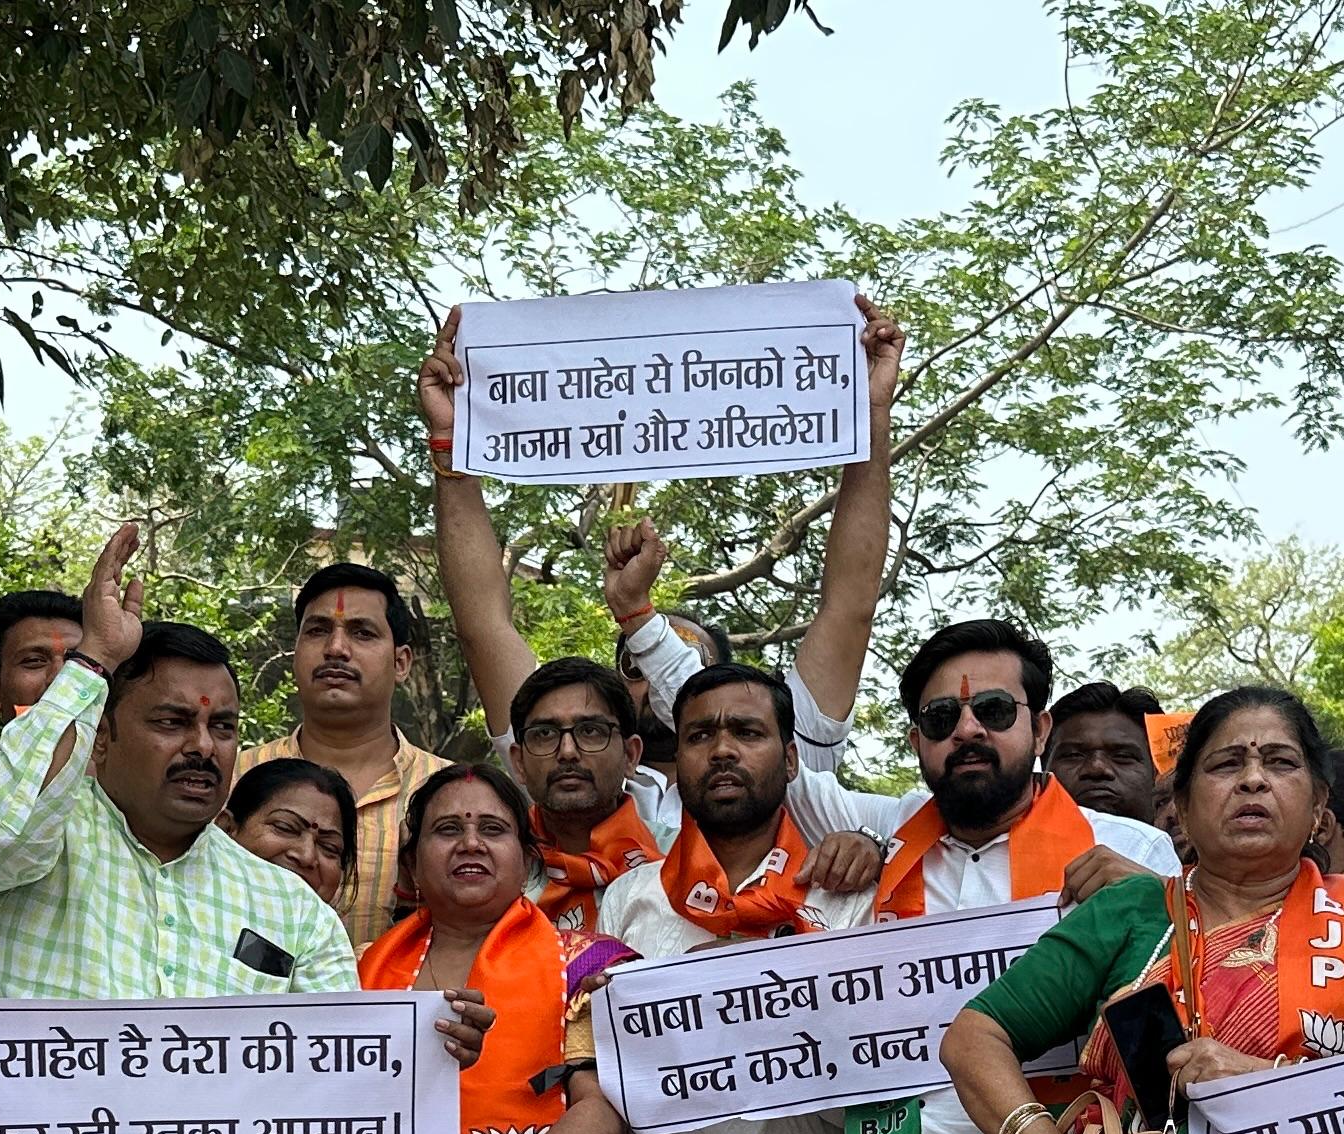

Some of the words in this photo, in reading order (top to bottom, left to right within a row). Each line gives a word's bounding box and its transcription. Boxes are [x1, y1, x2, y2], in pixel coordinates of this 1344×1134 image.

[488, 370, 548, 405] बाबा
[557, 357, 637, 400] साहेब
[644, 353, 673, 394] से
[681, 347, 785, 392] जिनको
[794, 346, 850, 391] द्वेष,
[483, 427, 572, 463] आजम
[580, 409, 627, 457] खां
[633, 409, 690, 454] और
[697, 404, 839, 449] अखिलेश।
[619, 994, 704, 1038] बाबा
[713, 969, 818, 1024] साहेब
[828, 965, 884, 1006] का
[898, 943, 1034, 998] अपमा
[120, 1024, 152, 1077] है
[161, 1025, 229, 1075] देश
[241, 1022, 297, 1073] की
[309, 1034, 403, 1078] शान,
[658, 1055, 736, 1100] बन्द
[745, 1032, 837, 1086] करो,
[849, 1023, 929, 1069] बन्द
